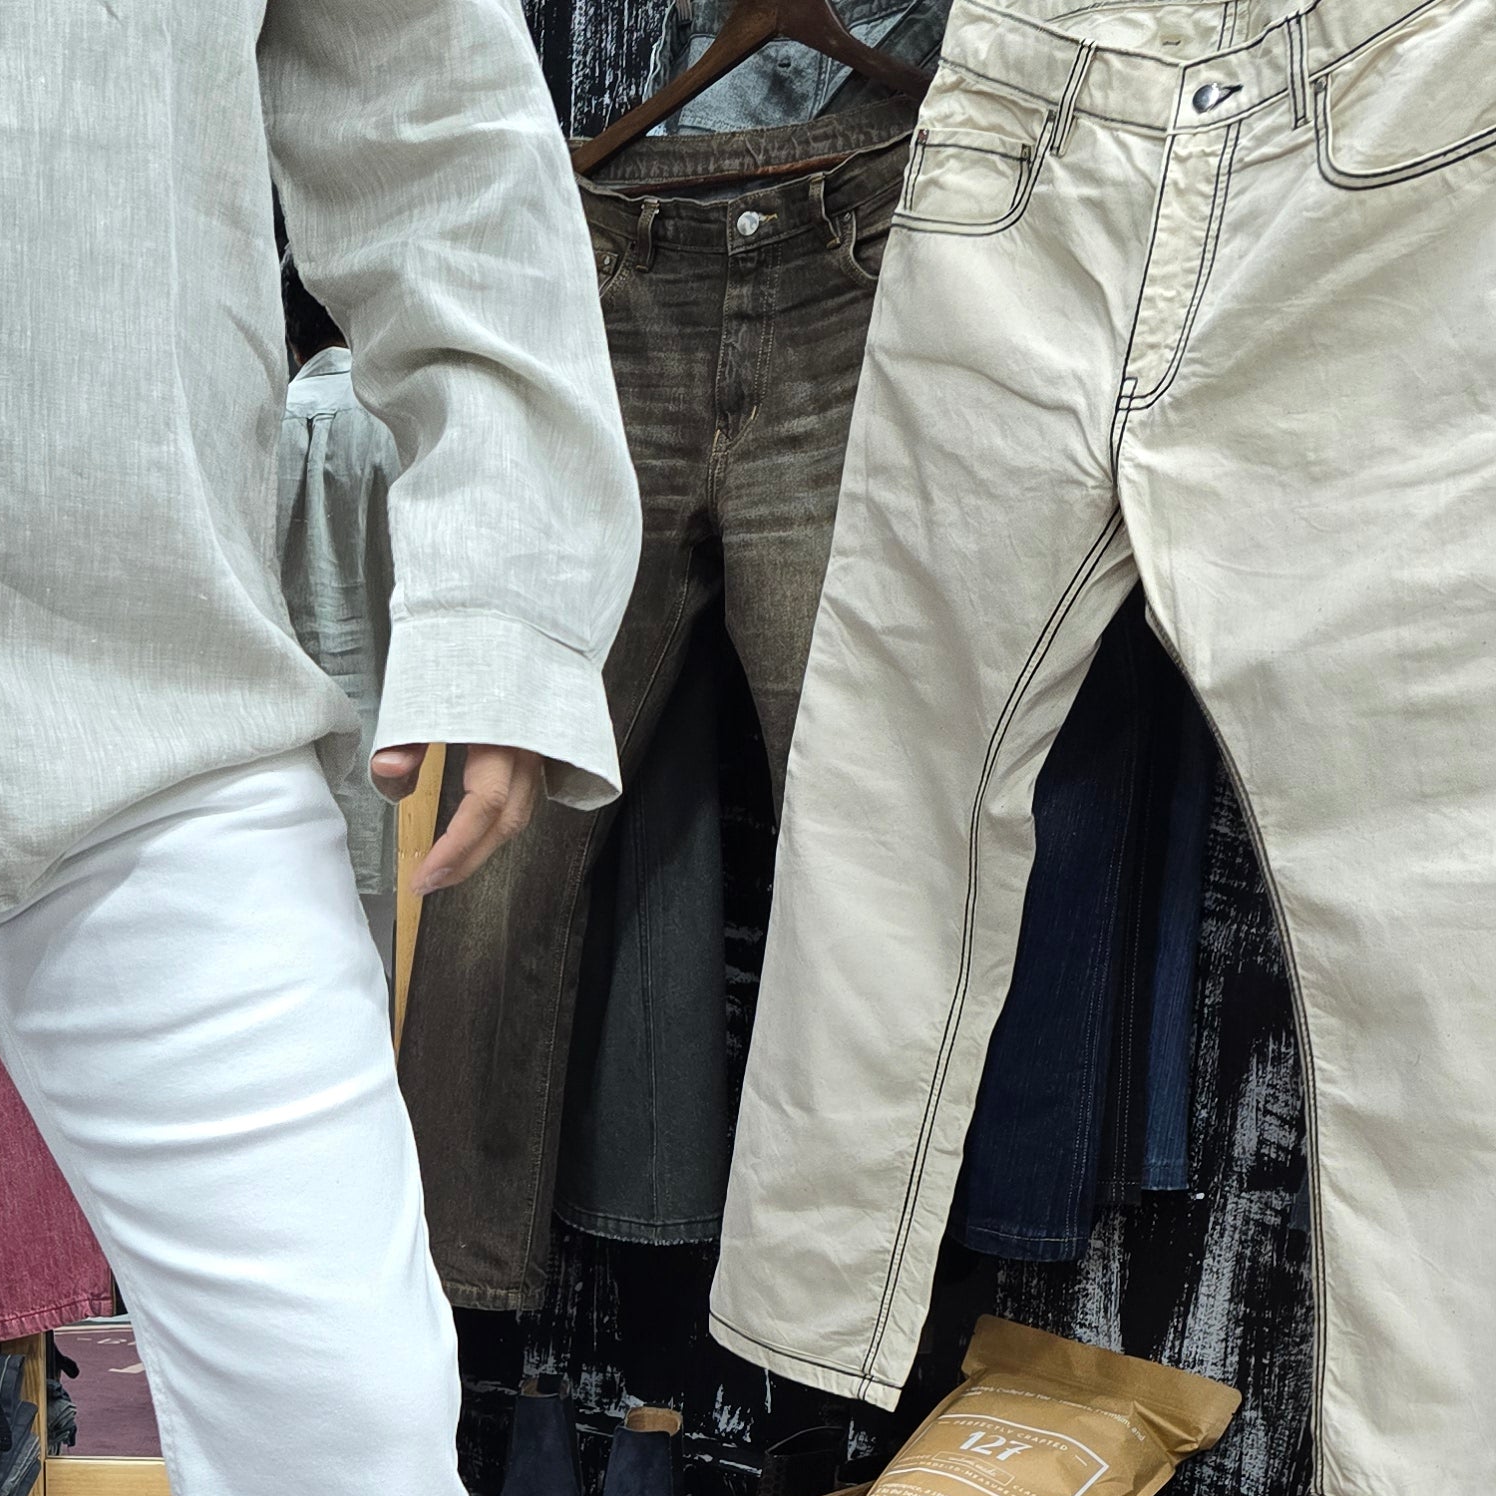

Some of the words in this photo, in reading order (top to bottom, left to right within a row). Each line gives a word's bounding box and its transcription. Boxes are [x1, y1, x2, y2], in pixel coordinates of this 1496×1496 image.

[953, 1419, 1013, 1435] PERFECTLY
[1017, 1431, 1068, 1452] CRAFTED
[959, 1430, 1034, 1462] 127
